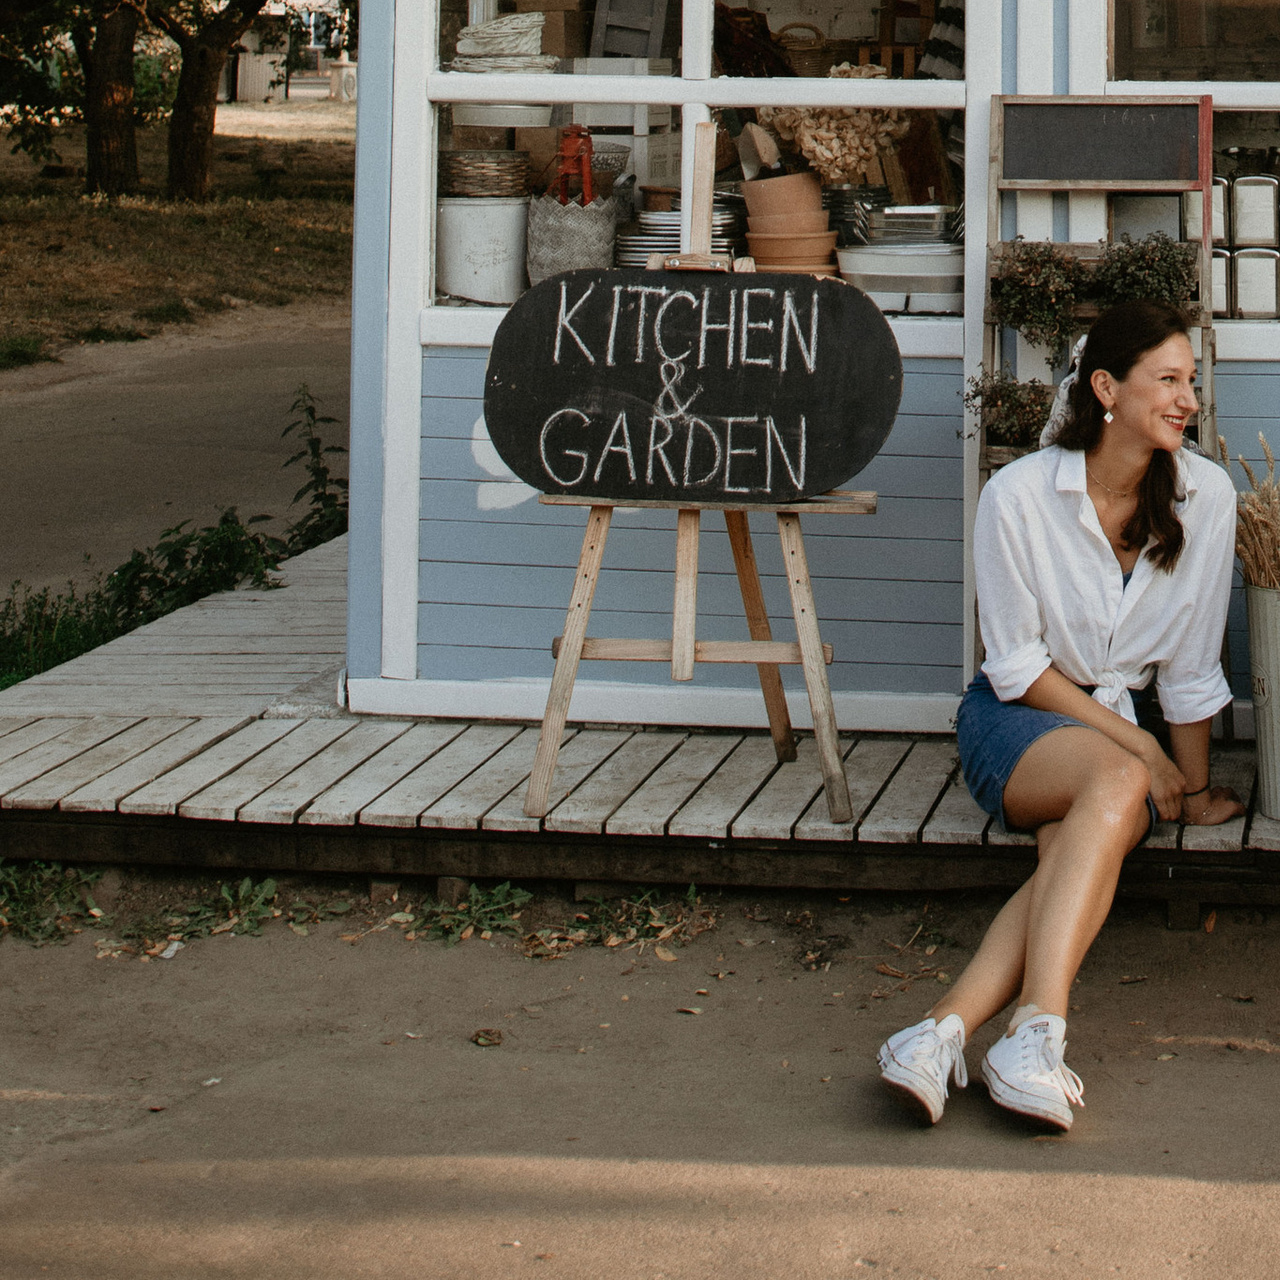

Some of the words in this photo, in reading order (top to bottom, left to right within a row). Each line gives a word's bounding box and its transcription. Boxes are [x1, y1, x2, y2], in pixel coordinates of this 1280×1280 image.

[553, 280, 819, 374] KITCHEN
[655, 359, 703, 419] &
[540, 408, 806, 493] GARDEN
